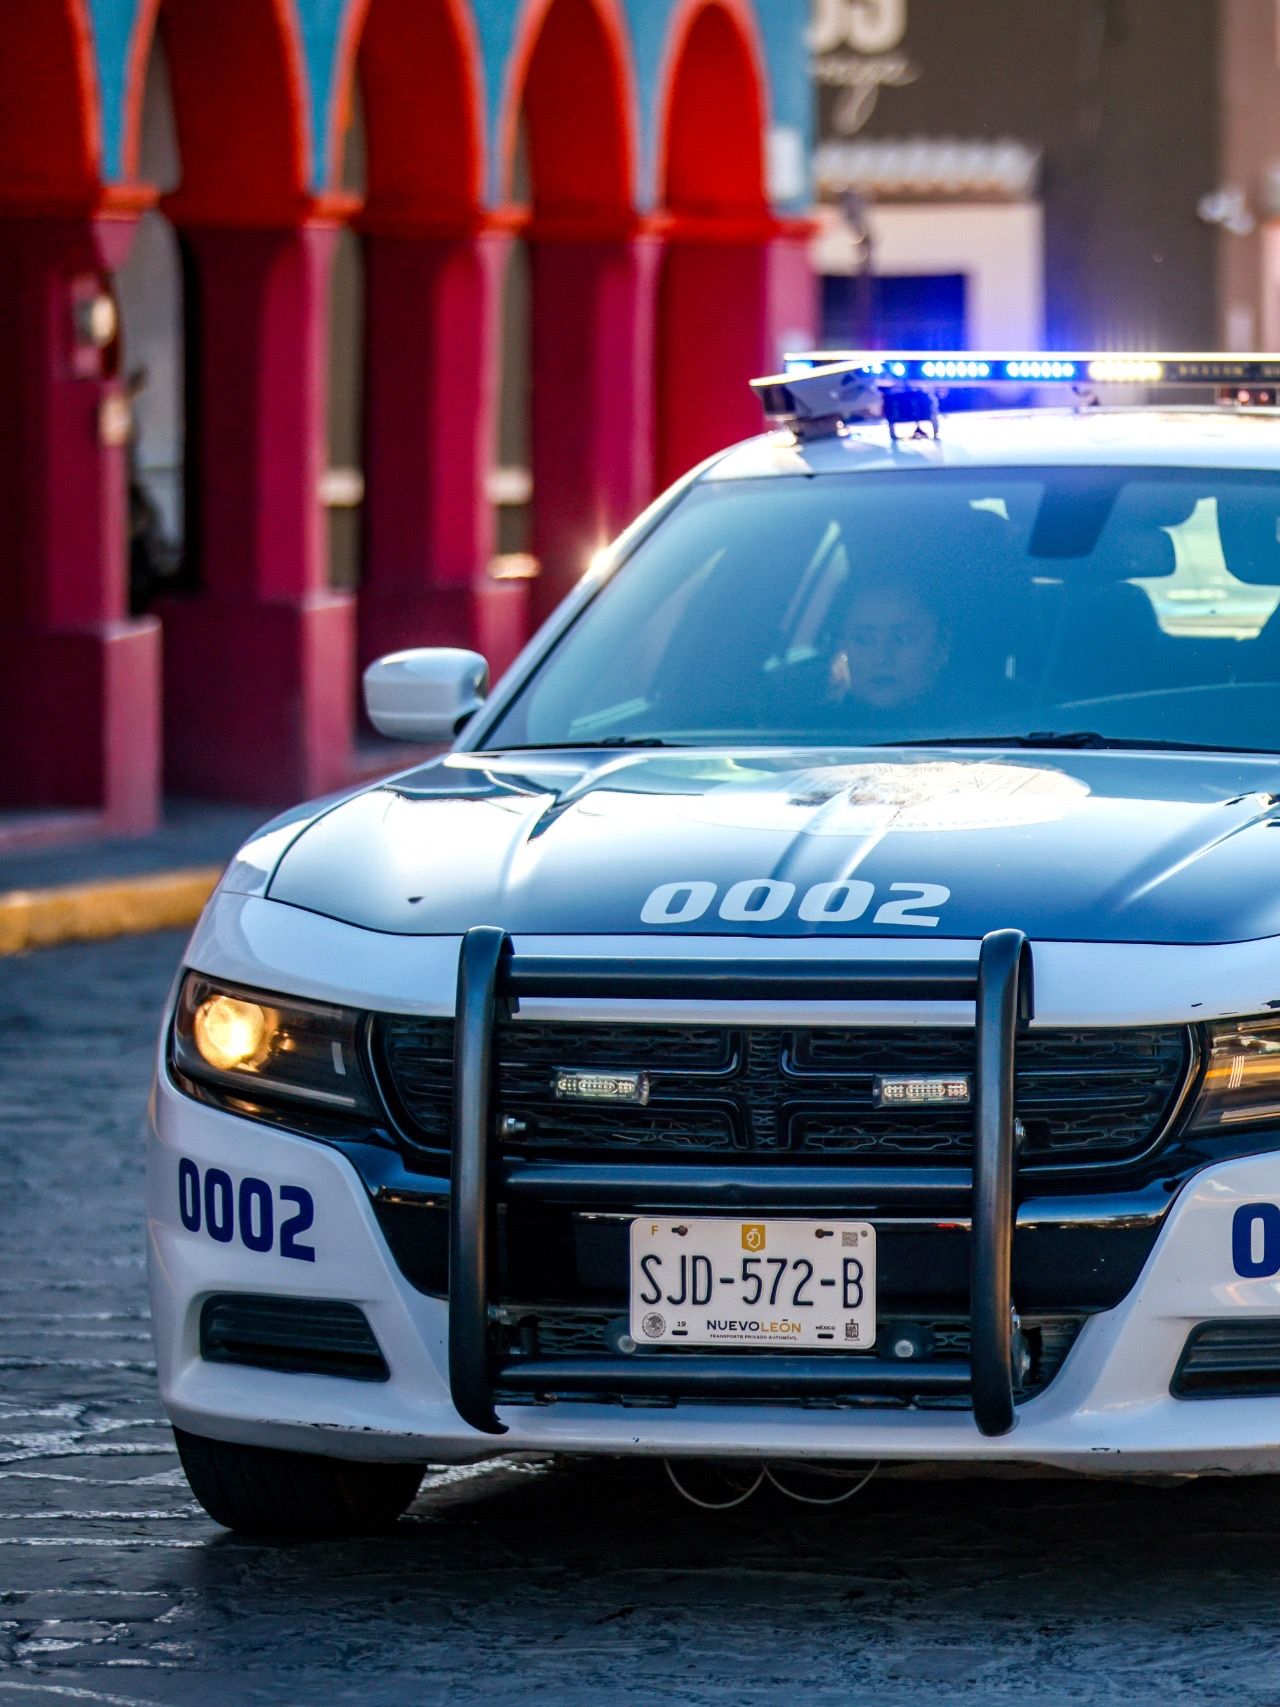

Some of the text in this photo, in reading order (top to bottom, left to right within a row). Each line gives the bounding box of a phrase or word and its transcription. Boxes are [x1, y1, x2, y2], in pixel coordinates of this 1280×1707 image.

[640, 879, 950, 927] 0002
[178, 1157, 316, 1262] 0002
[650, 1225, 659, 1236] F
[640, 1254, 864, 1308] SJD-572-B
[677, 1320, 687, 1328] 19
